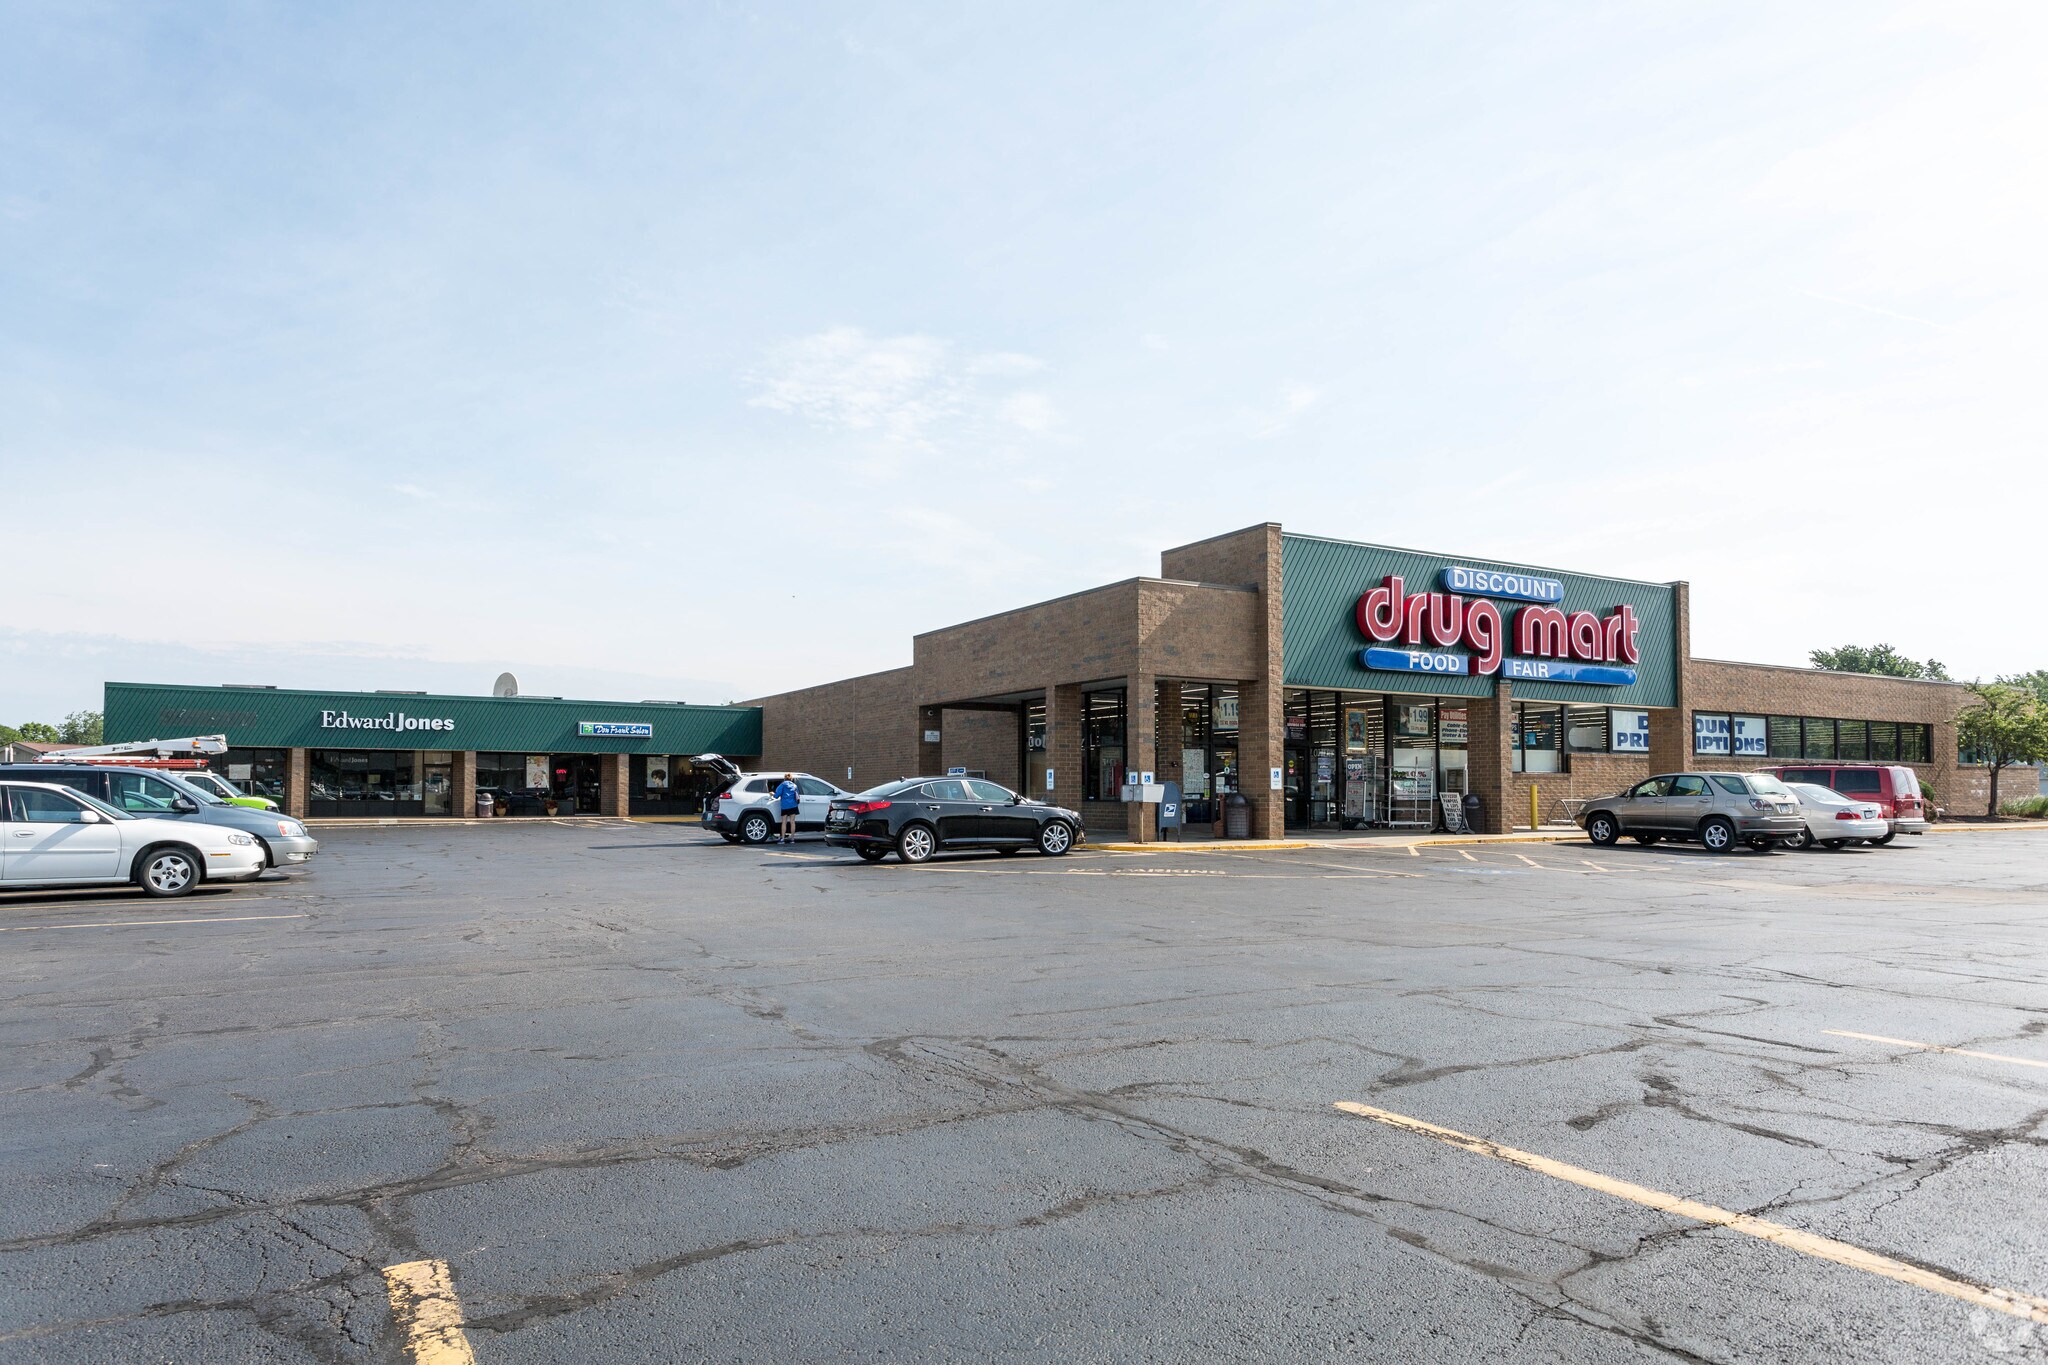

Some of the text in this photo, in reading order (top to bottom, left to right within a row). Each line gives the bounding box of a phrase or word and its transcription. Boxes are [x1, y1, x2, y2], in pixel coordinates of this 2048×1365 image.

[1453, 568, 1558, 599] DISCOUNT
[1357, 575, 1639, 676] drug mart
[1408, 651, 1549, 678] FOOD FAIR
[321, 710, 455, 732] Edward Jones
[595, 725, 609, 733] Don
[630, 726, 649, 735] Salon
[351, 756, 368, 764] Jones
